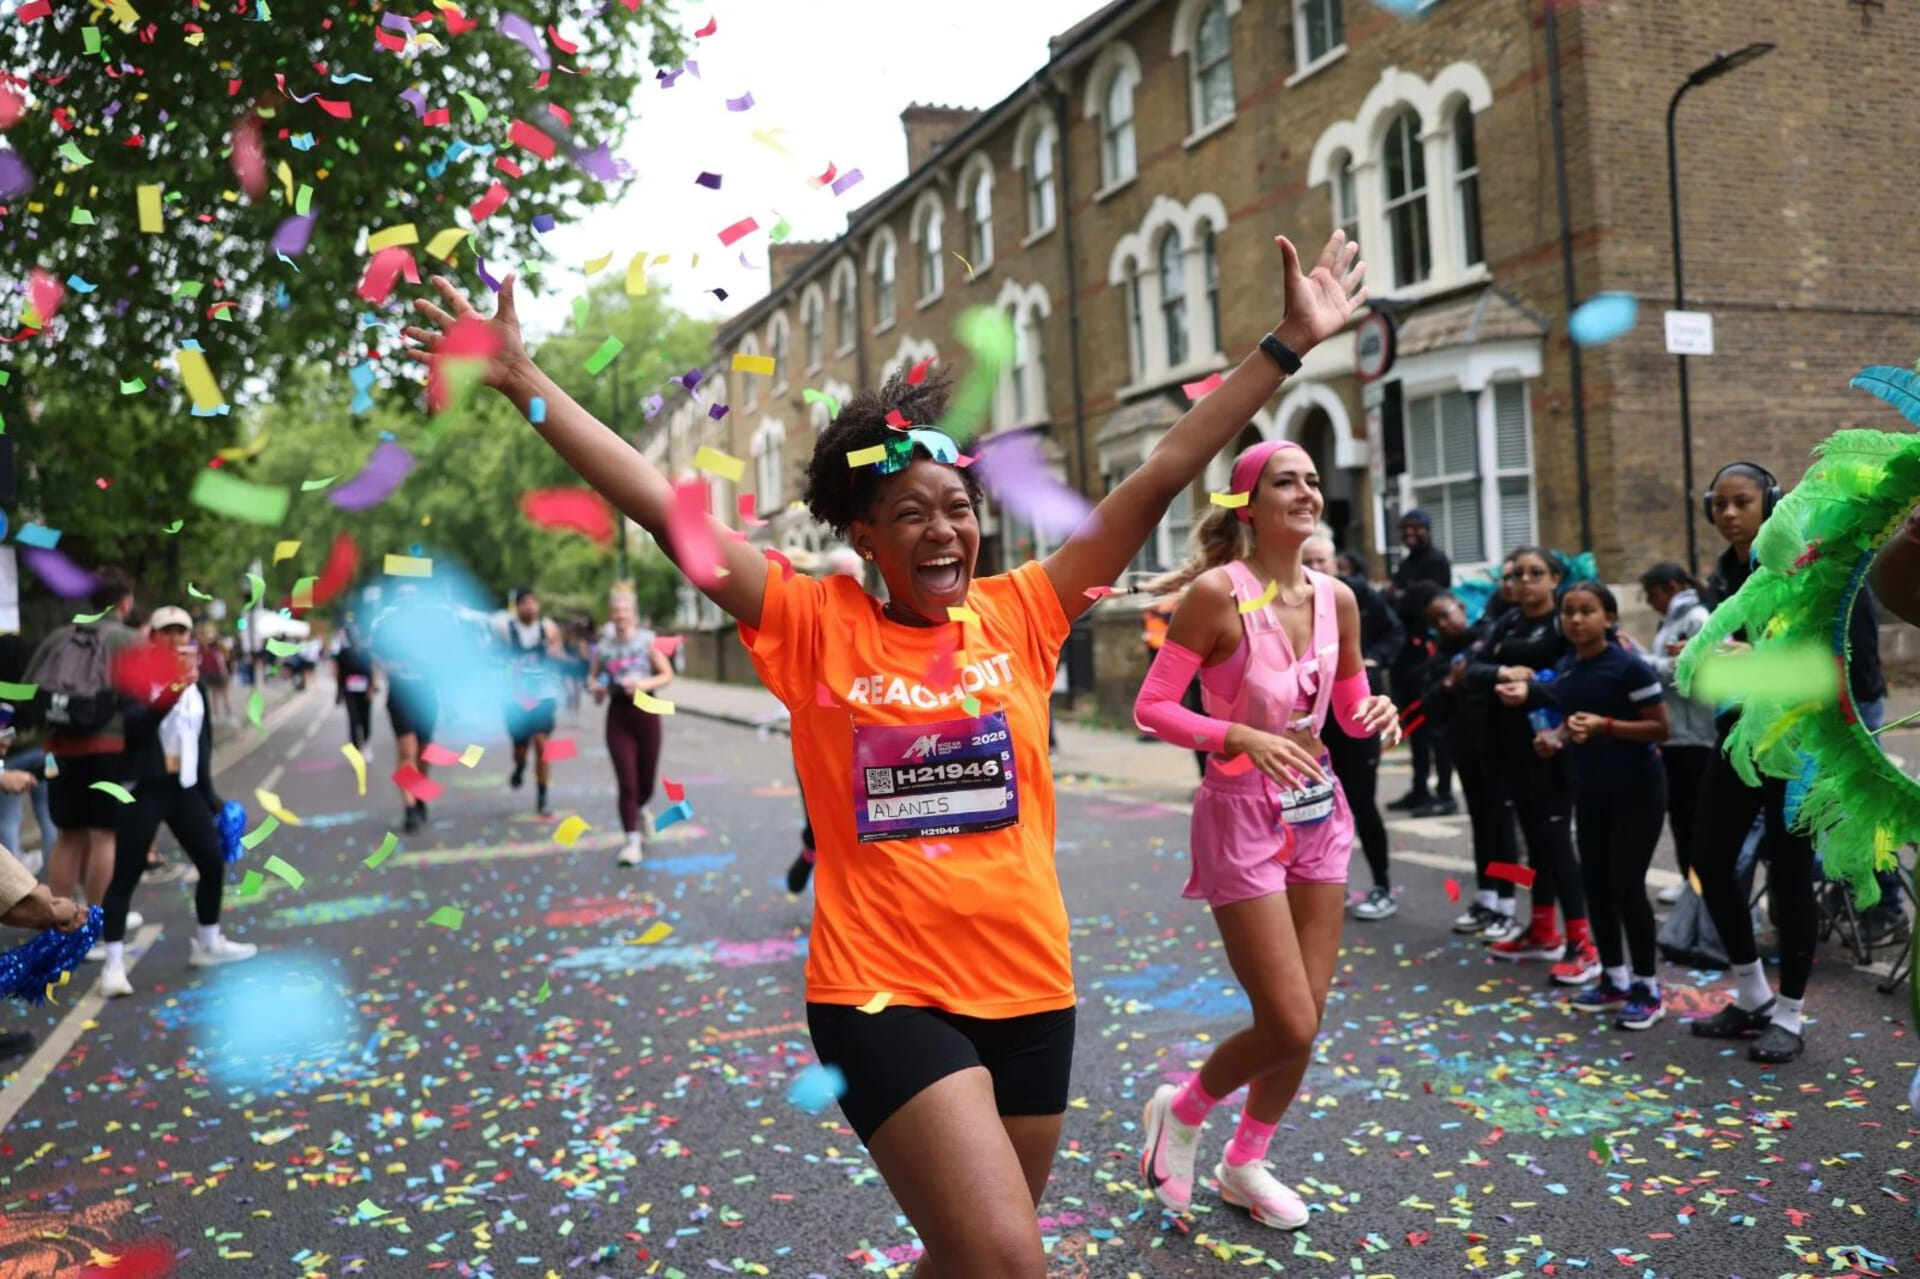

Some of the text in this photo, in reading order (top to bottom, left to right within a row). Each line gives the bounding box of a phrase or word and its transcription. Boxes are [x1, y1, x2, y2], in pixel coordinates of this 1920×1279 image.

[971, 730, 1007, 746] 2025
[896, 759, 1000, 785] H21946
[874, 797, 950, 819] ALANIS
[920, 826, 960, 836] H21946
